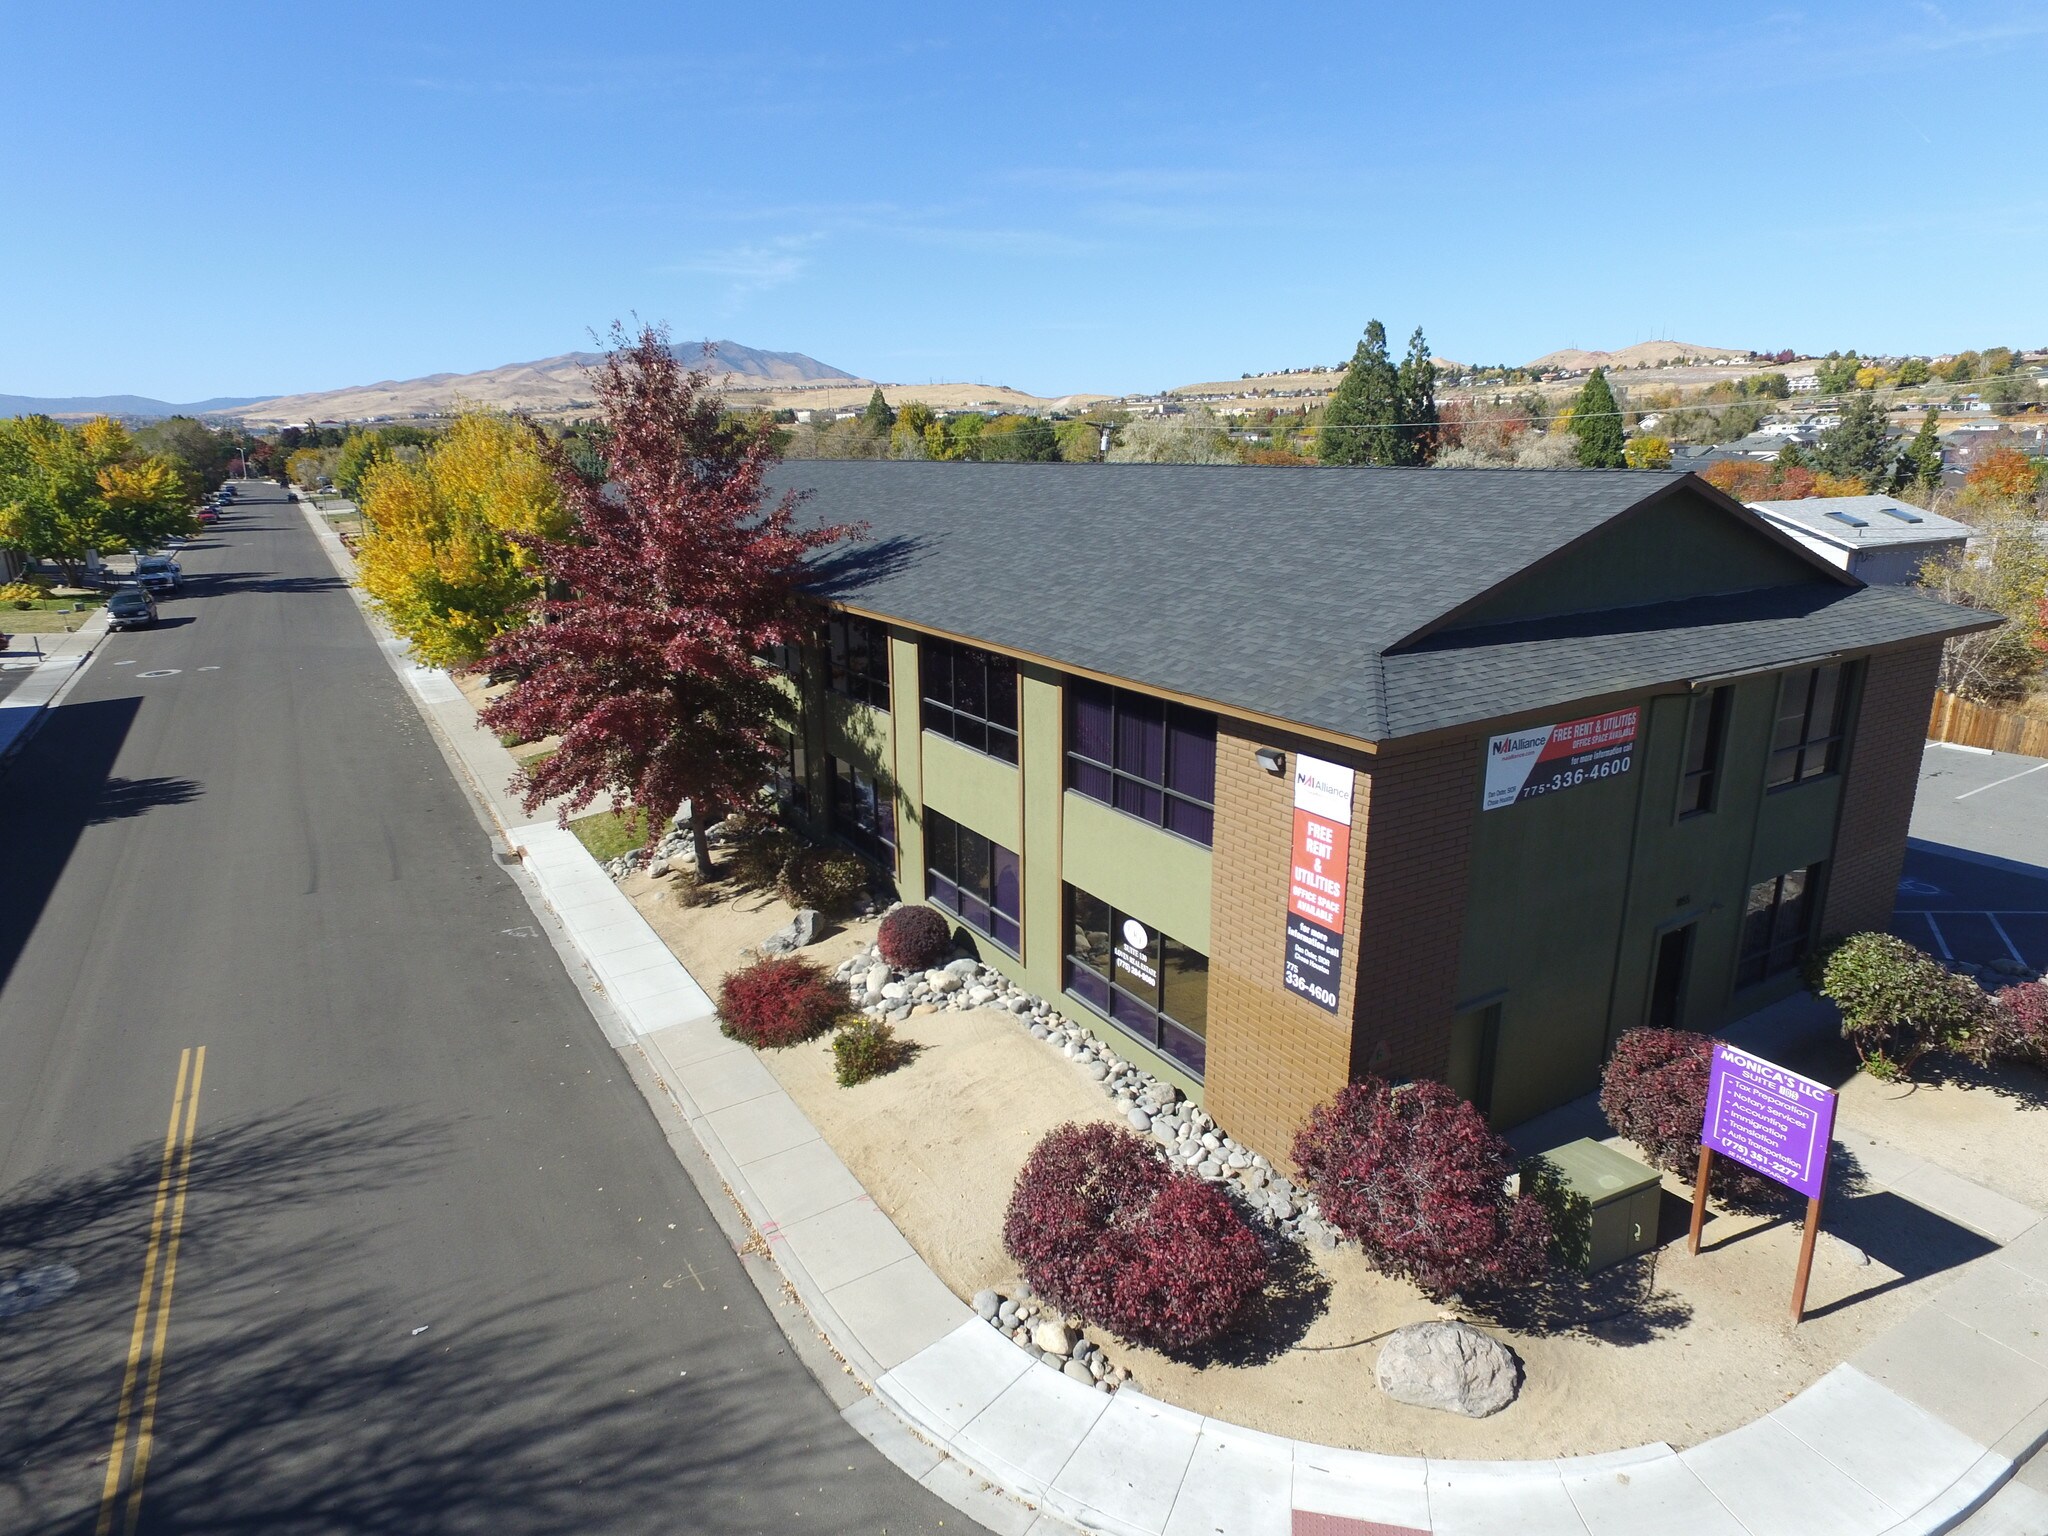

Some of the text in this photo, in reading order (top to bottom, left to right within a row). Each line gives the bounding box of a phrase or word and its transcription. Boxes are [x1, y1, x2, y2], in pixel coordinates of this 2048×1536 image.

[1553, 712, 1636, 742] FREE RENT & UTILITIES
[1572, 727, 1635, 749] OFFICE SPACE AVAILABLE
[1580, 754, 1592, 763] more
[1594, 746, 1622, 760] information
[1623, 744, 1632, 752] call
[1523, 756, 1631, 798] 775-336-4600
[1308, 822, 1333, 843] FREE
[1306, 838, 1332, 859] RENT
[1313, 858, 1322, 874] &
[1295, 866, 1340, 898] UTILITIES
[1293, 886, 1339, 913] OFFICE SPACE
[1297, 900, 1333, 923] AVAILABLE
[1288, 926, 1339, 958] information call
[1300, 923, 1328, 942] for more
[1123, 943, 1139, 958] SUITE
[1116, 958, 1130, 973] (775)
[1129, 956, 1140, 968] REAL
[1141, 963, 1156, 977] ESTATE
[1287, 961, 1298, 973] 775
[1286, 971, 1336, 1007] 336-4600
[1720, 1050, 1825, 1102] MONICA'S LLC
[1742, 1070, 1776, 1090] SUITE
[1733, 1091, 1807, 1129] Notary Services
[1734, 1080, 1810, 1119] Tax Preparation
[1731, 1111, 1787, 1141] Immigration
[1732, 1102, 1788, 1132] Accounting
[1729, 1120, 1778, 1148] Translation
[1721, 1137, 1799, 1179] (775) 351-2277
[1728, 1130, 1802, 1169] Auto Transportation
[1736, 1154, 1757, 1168] HABLA
[1758, 1164, 1790, 1184] ESPAÑOL
